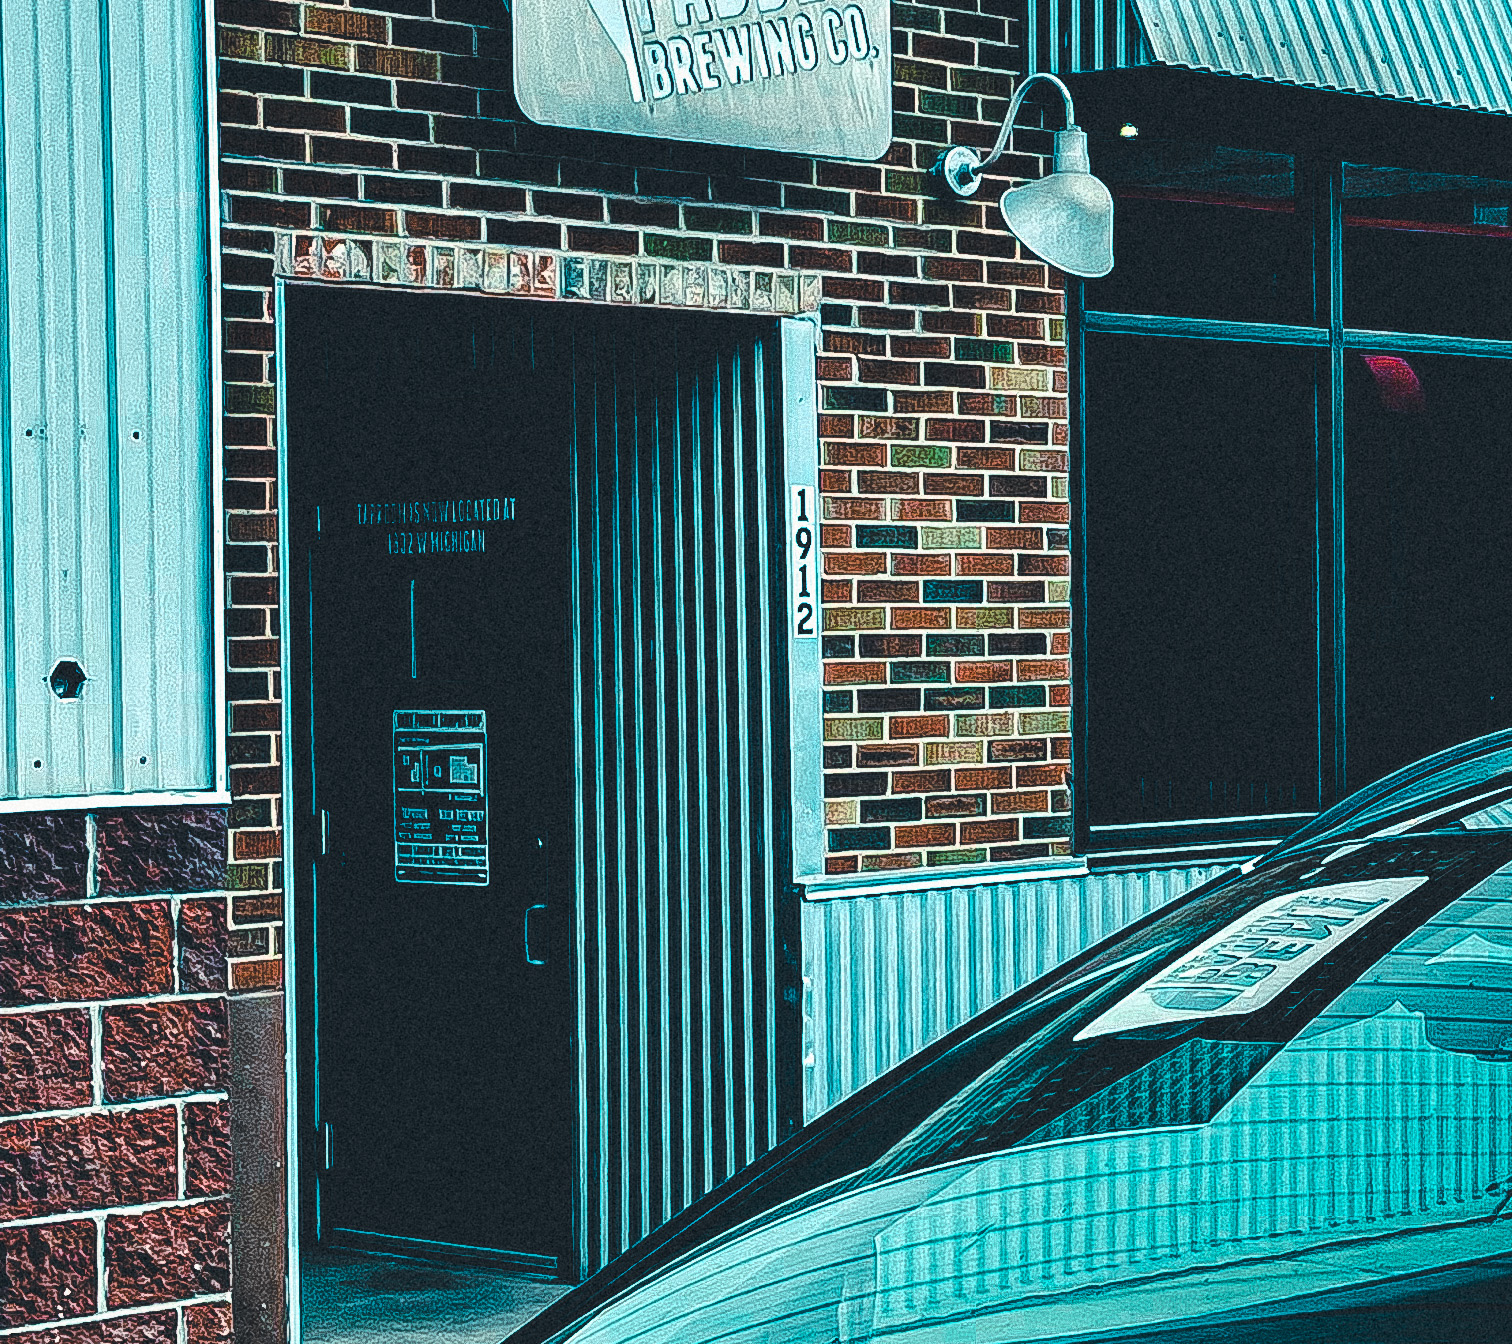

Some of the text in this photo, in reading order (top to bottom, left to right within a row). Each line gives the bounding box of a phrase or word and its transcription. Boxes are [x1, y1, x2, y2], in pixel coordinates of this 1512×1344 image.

[643, 3, 880, 102] BREWING CO.
[409, 501, 421, 524] IS
[452, 498, 500, 523] LOCATED
[503, 497, 516, 521] AT
[416, 531, 428, 554] W
[430, 529, 486, 553] MICHIGAN
[795, 488, 814, 636] 1912
